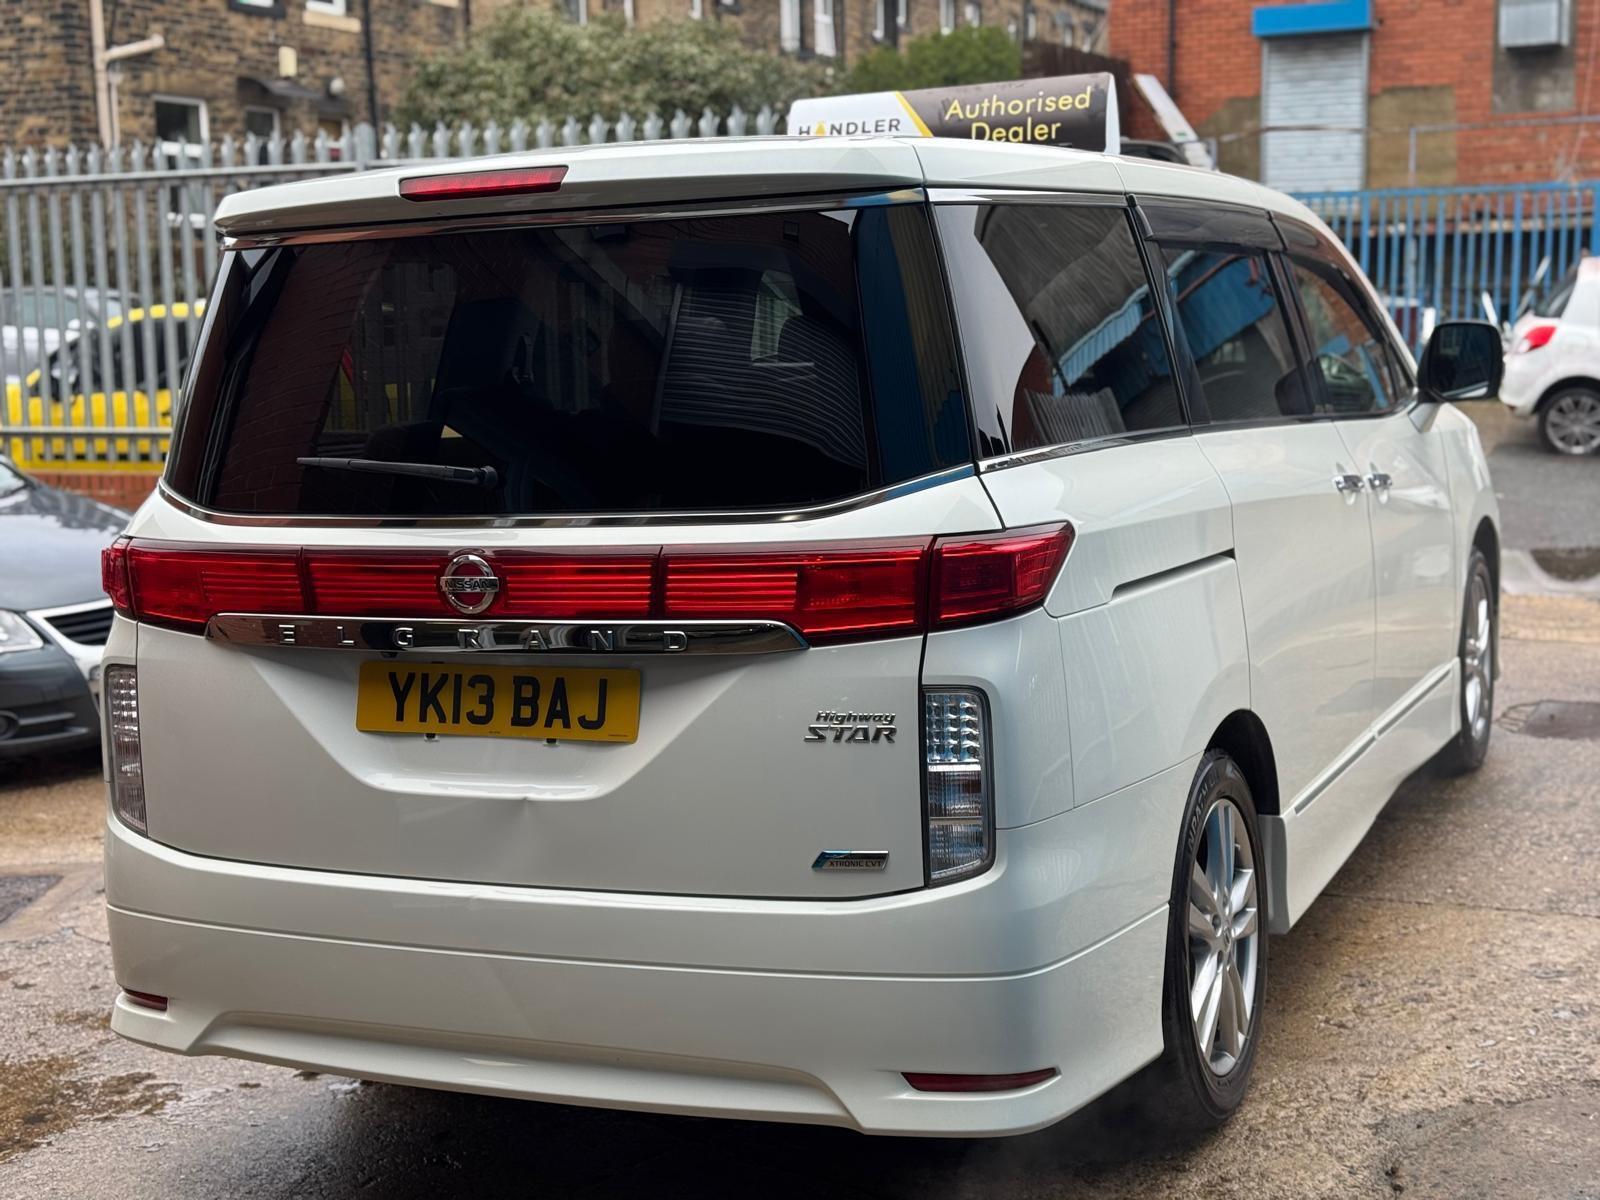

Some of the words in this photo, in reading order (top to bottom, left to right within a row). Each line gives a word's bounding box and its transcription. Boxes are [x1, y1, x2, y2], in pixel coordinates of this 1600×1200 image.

[945, 86, 1092, 121] Authorised
[971, 118, 1062, 143] Dealer
[444, 579, 492, 591] NISSAN
[279, 624, 689, 651] ELGRAND
[388, 671, 495, 725] YK13
[510, 675, 610, 731] BAJ
[815, 710, 897, 725] Highway
[803, 724, 898, 743] STAR
